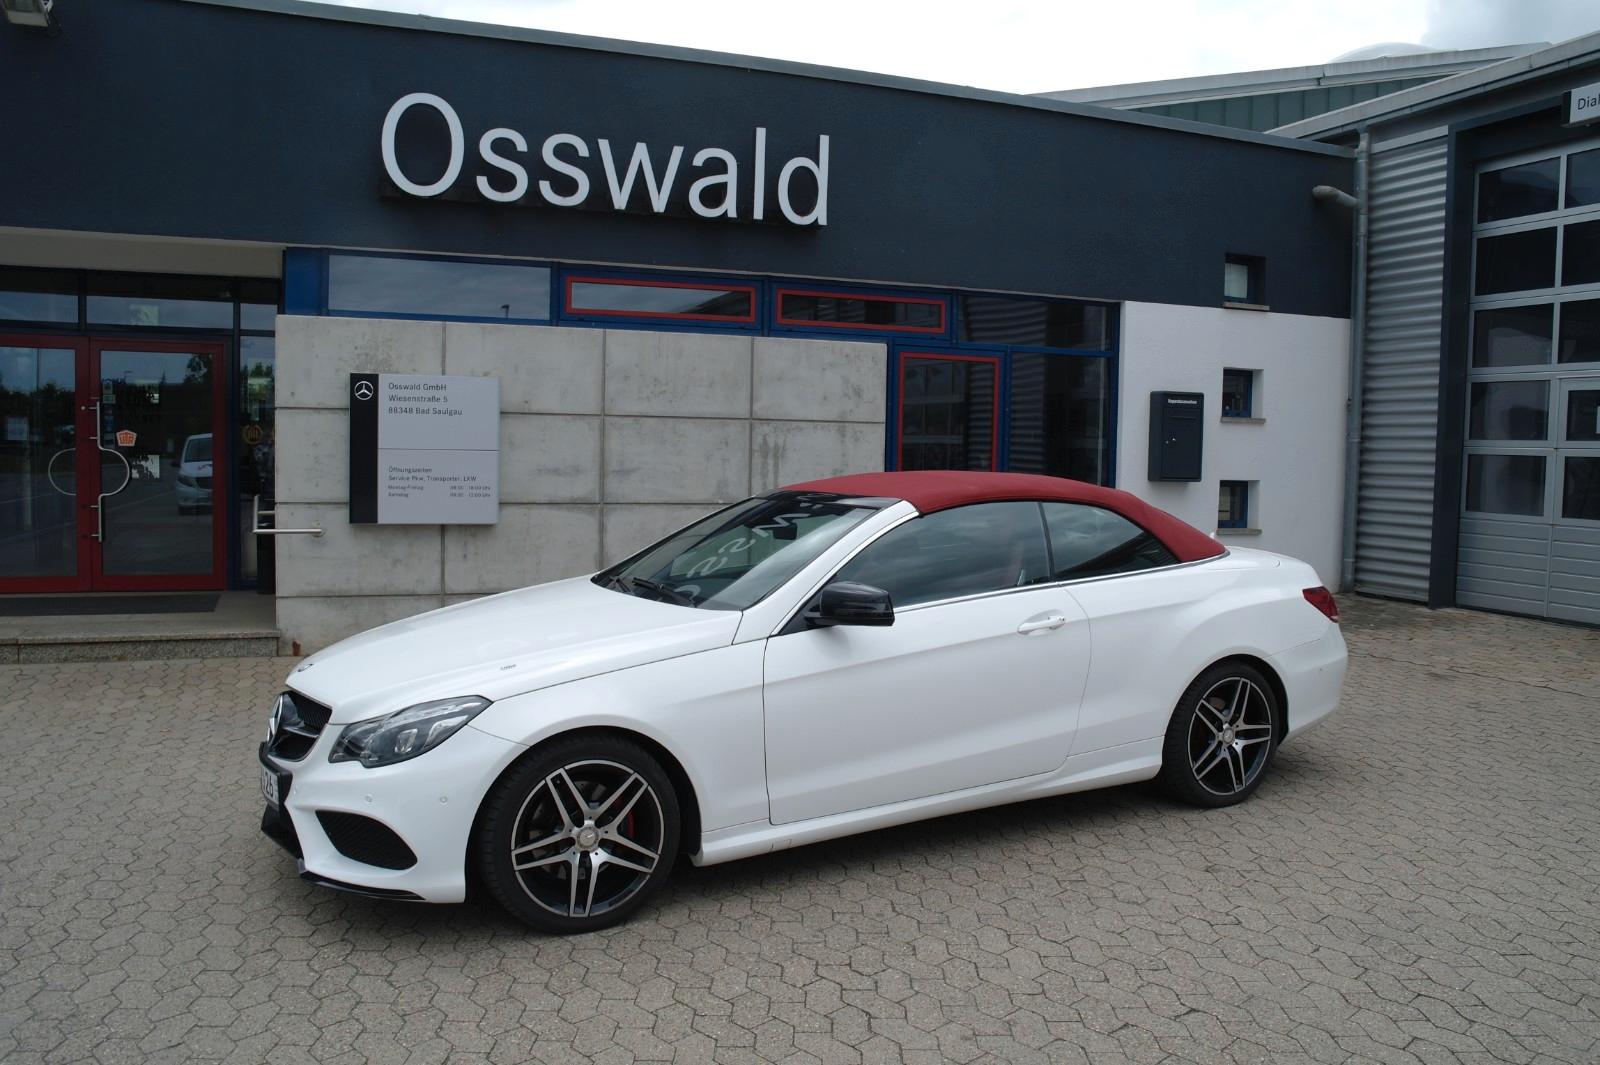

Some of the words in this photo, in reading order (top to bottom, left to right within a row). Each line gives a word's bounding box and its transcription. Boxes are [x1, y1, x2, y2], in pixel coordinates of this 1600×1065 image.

[381, 92, 829, 226] Osswald
[388, 382, 421, 391] Osswald
[423, 383, 447, 391] GmbH
[388, 394, 441, 403] Wiesenstraße
[388, 407, 413, 415] 88348
[415, 407, 430, 415] Bad
[432, 407, 463, 416] Saulgau
